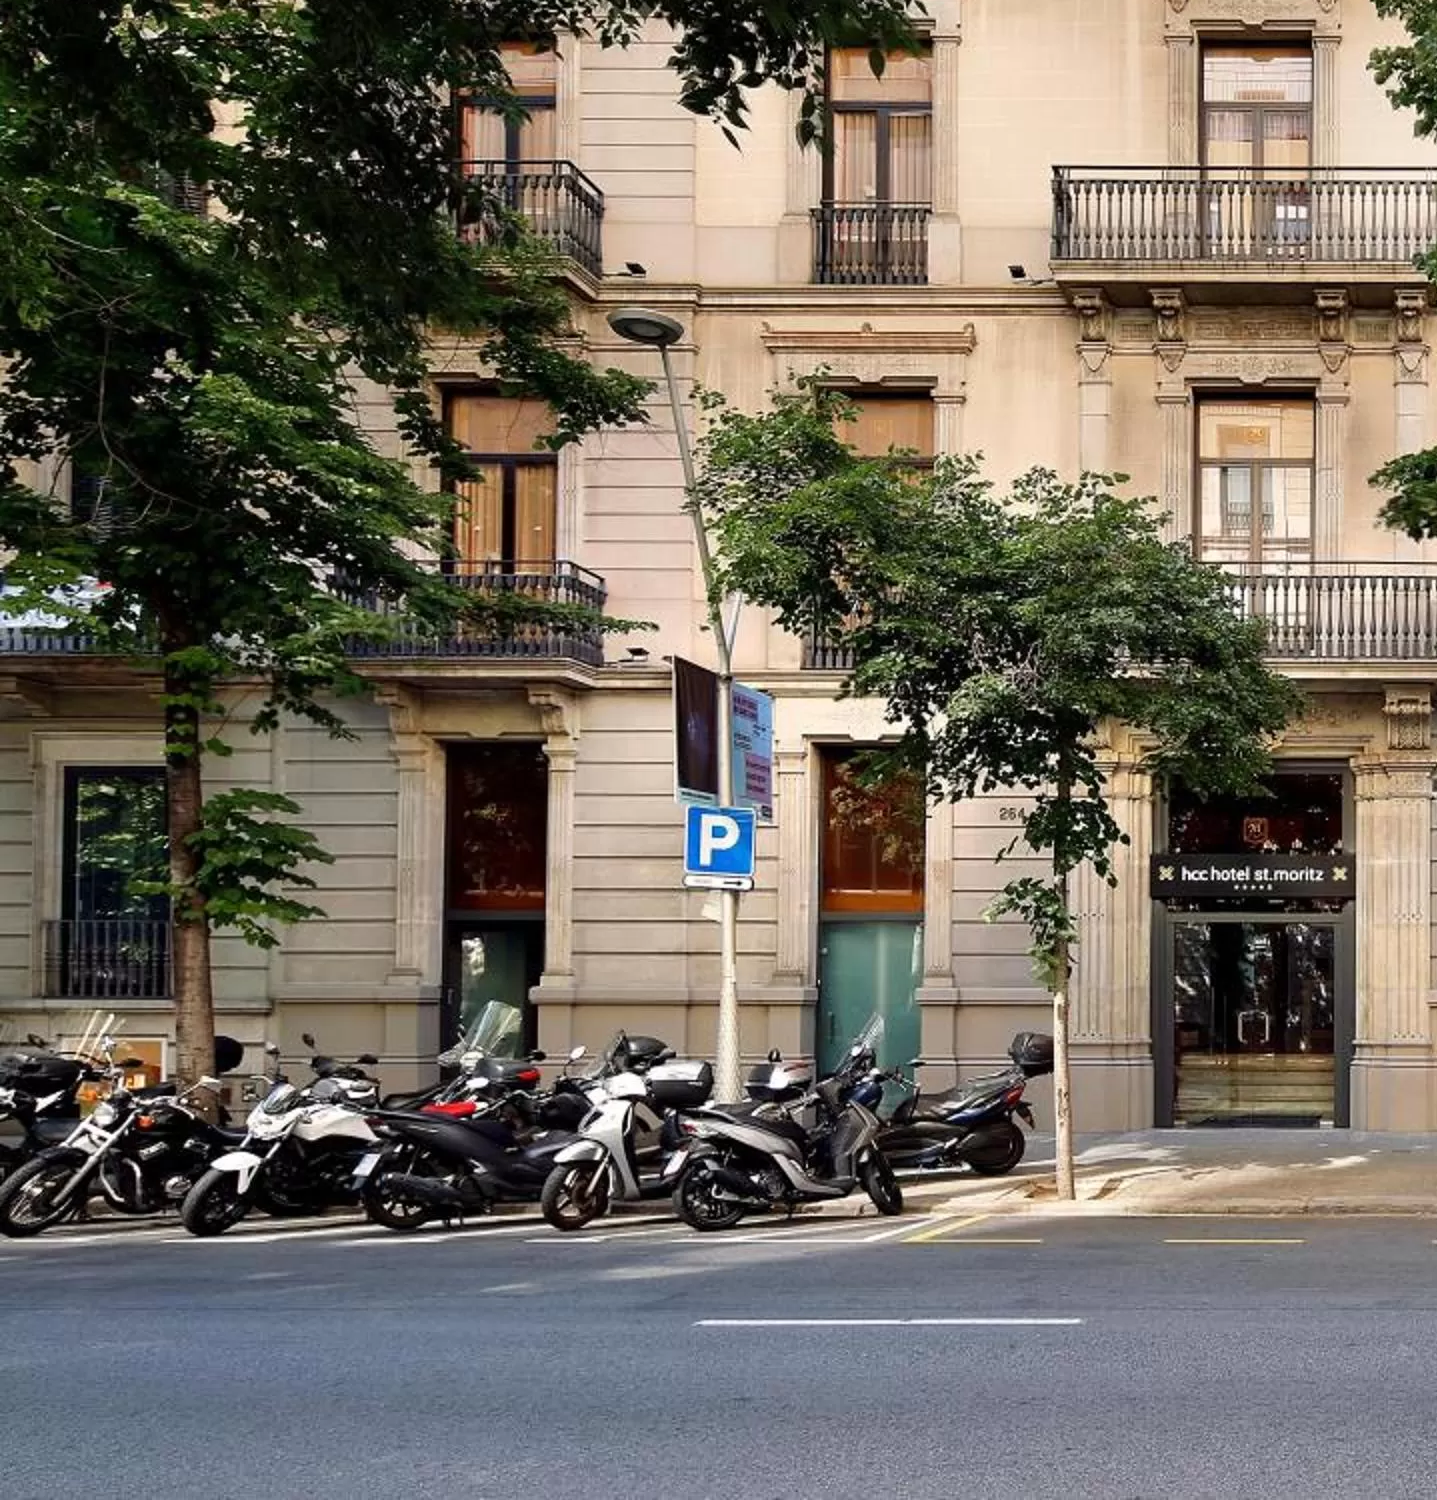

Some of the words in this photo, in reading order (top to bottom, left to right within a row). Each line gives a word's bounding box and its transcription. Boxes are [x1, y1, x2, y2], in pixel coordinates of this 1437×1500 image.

[699, 813, 740, 867] P
[1181, 865, 1209, 882] hcc
[1210, 865, 1250, 882] hotel
